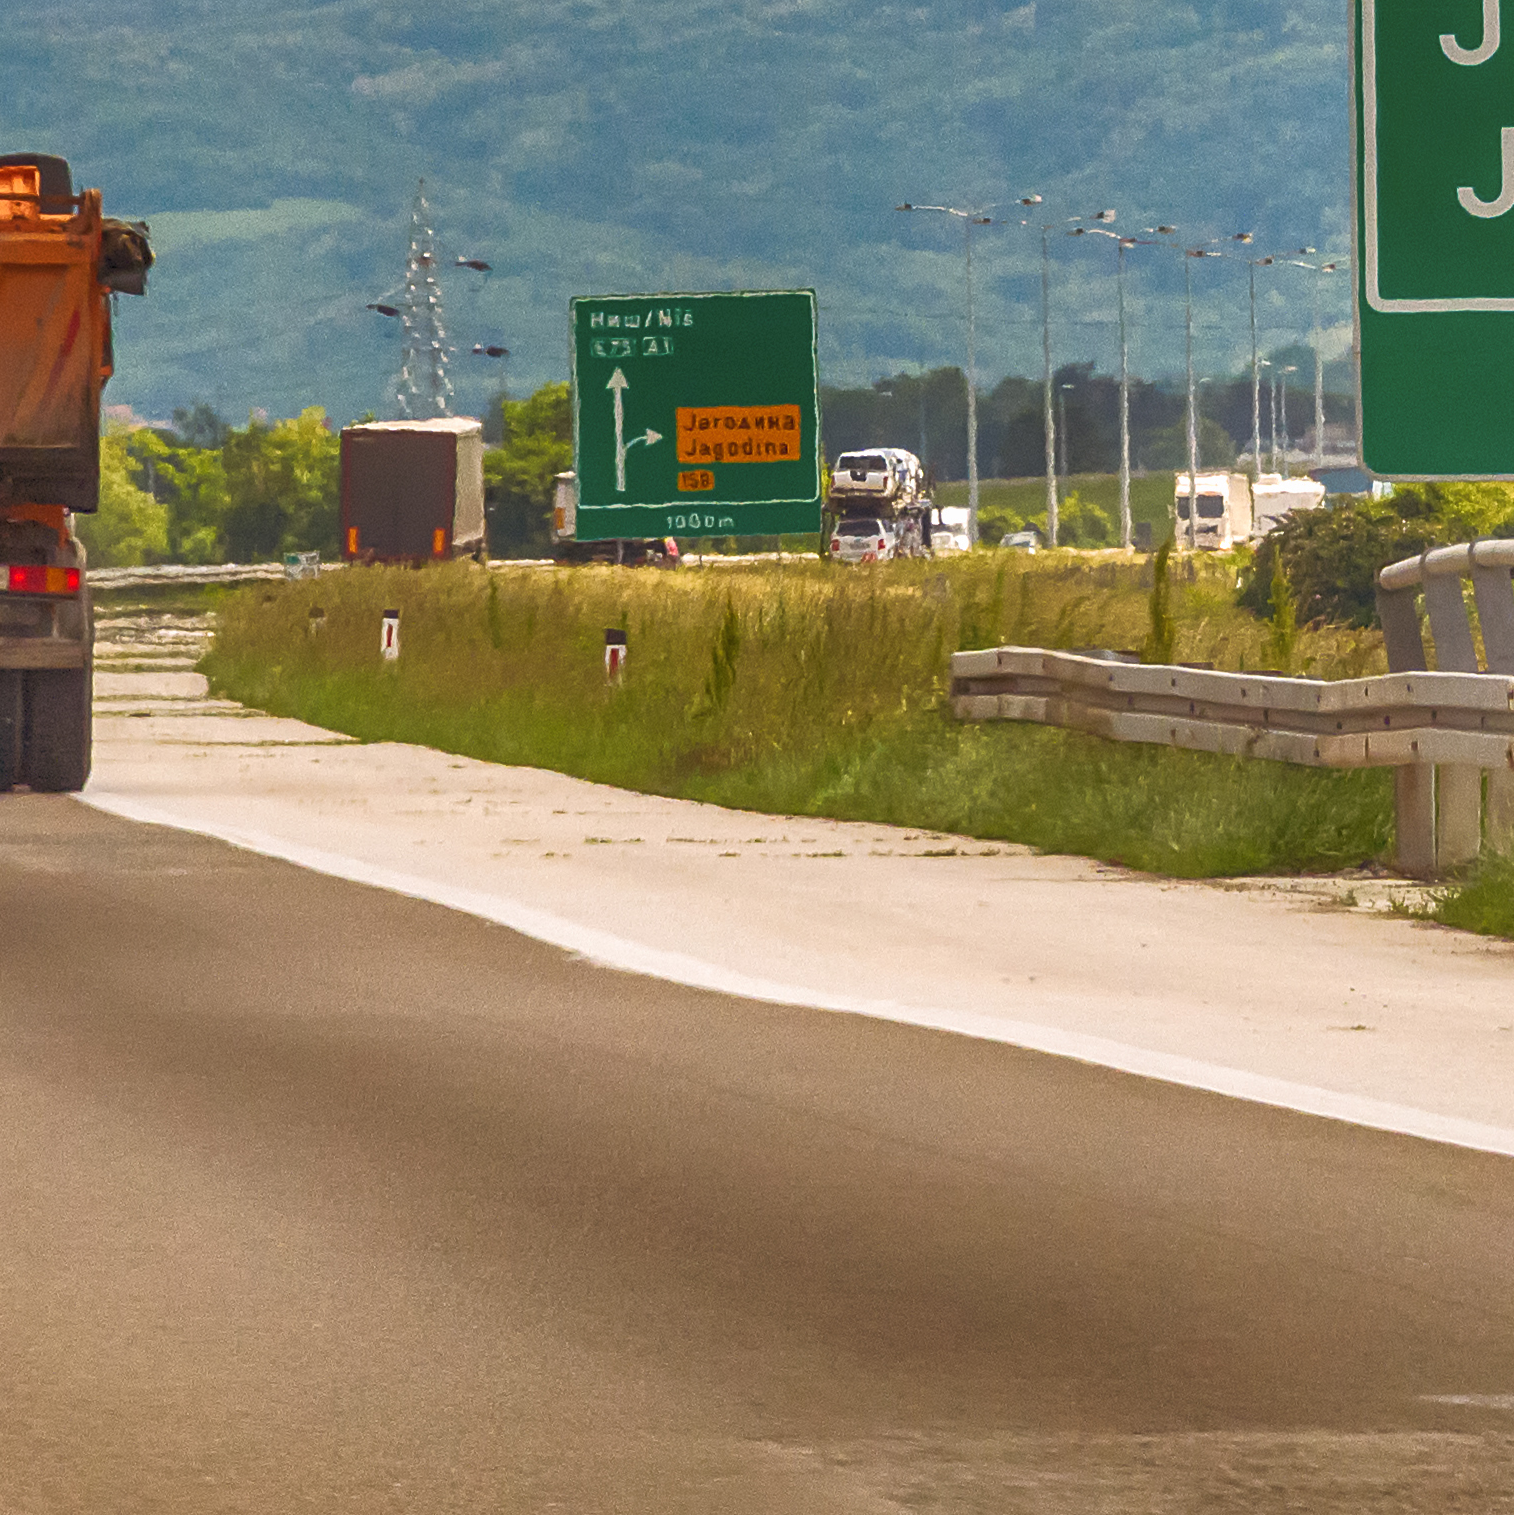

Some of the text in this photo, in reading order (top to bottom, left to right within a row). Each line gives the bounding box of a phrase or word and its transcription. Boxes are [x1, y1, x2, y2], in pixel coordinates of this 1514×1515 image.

[684, 413, 796, 431] Јагодина
[685, 437, 789, 461] Jagodina
[682, 471, 710, 489] 158
[666, 513, 735, 529] 1000 m
